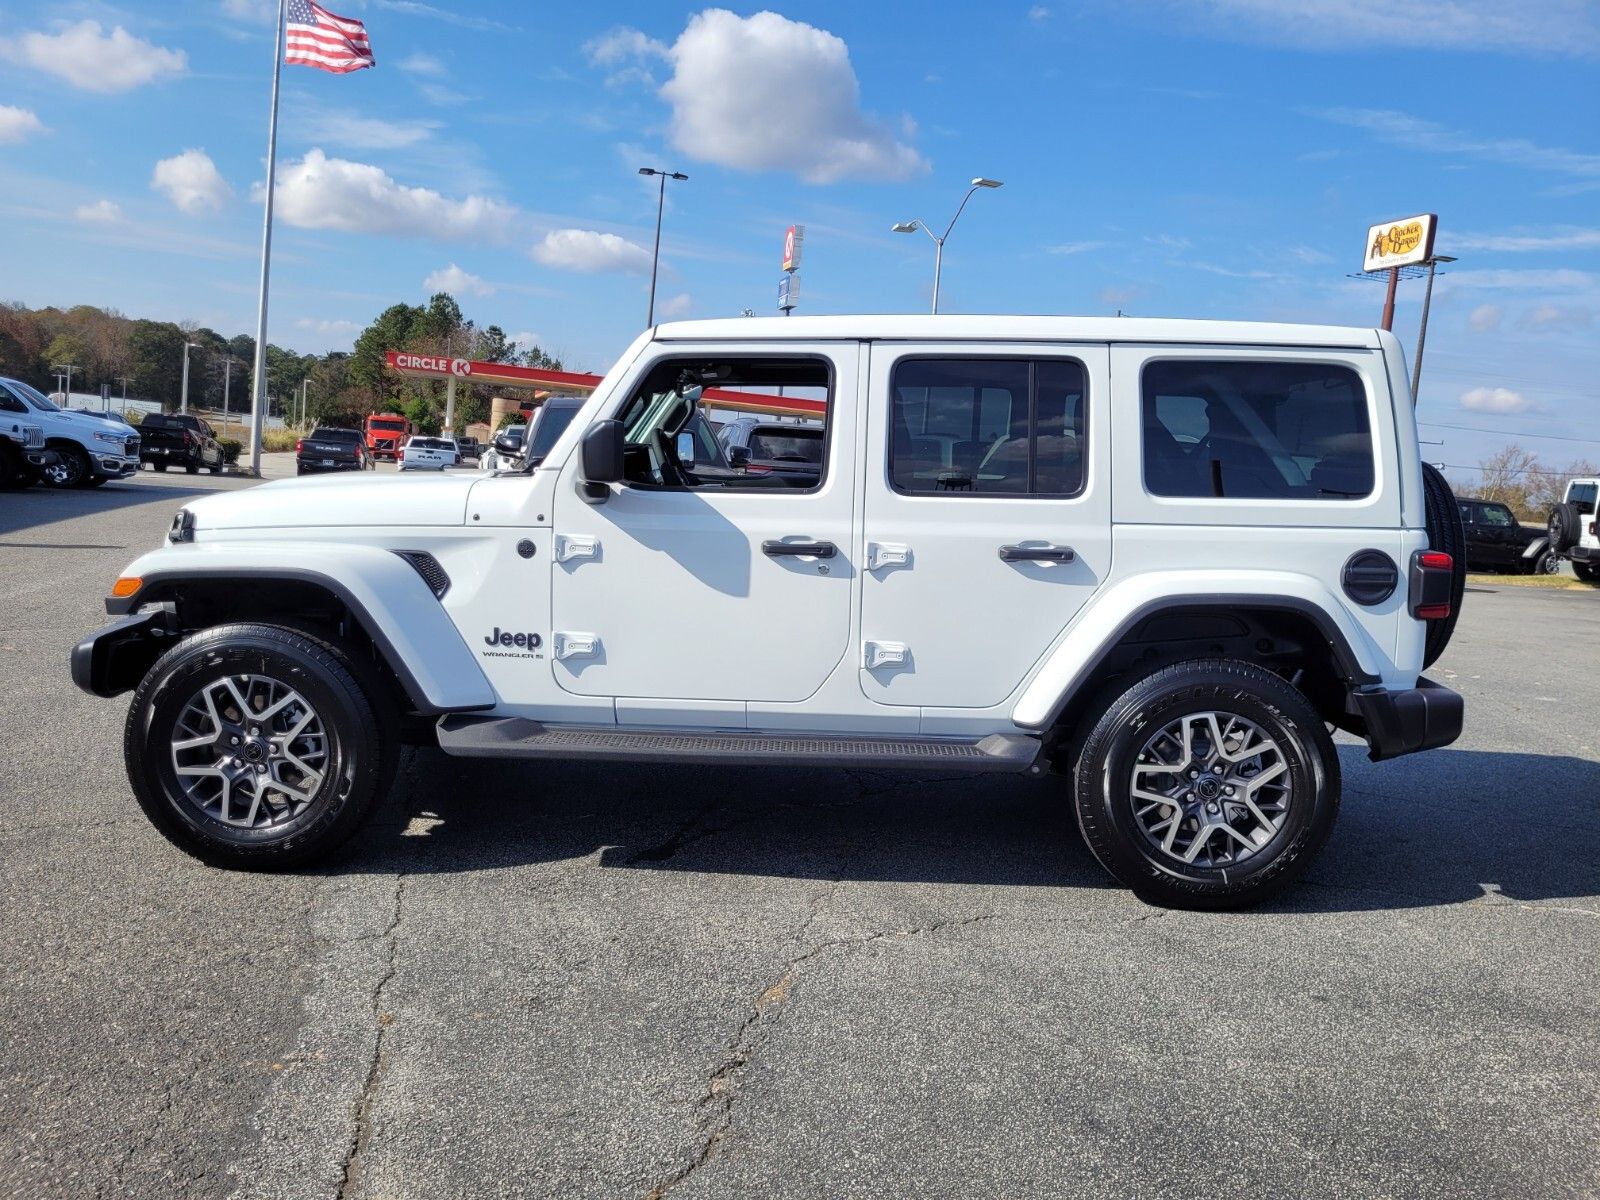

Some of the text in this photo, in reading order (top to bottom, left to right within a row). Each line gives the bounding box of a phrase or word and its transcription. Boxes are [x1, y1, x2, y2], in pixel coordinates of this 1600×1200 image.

[396, 355, 447, 371] CIRCLE
[484, 626, 542, 651] Jeep
[482, 651, 534, 659] WRANGLER
